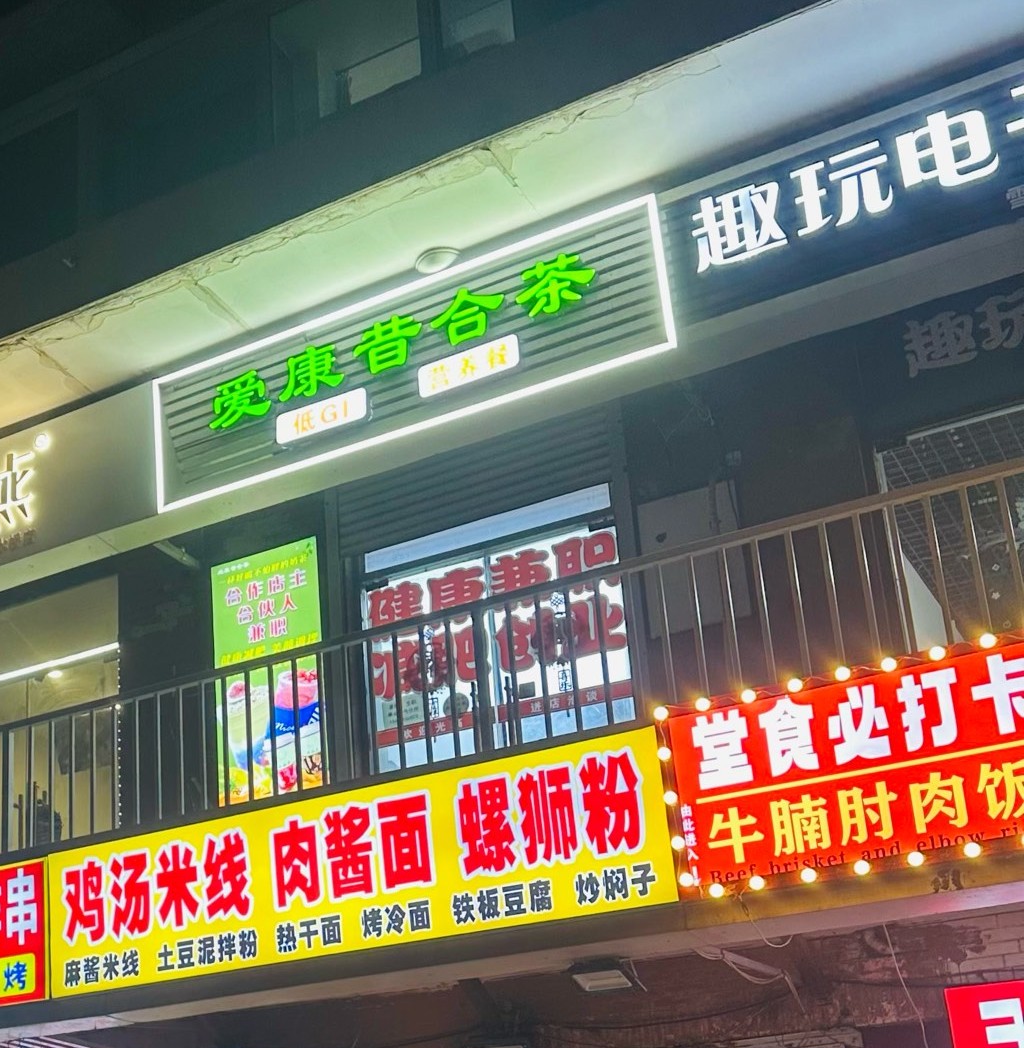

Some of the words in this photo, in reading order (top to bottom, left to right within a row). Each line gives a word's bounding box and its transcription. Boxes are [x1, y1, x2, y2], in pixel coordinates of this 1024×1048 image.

[209, 253, 596, 430] 爱康昔合茶
[293, 400, 349, 435] 低GI
[225, 568, 307, 606] 合作店主
[237, 593, 297, 624] 合伙人
[248, 617, 288, 643] 兼职
[691, 653, 1024, 790] 堂食必打卡
[708, 759, 1024, 864] 牛腩肘肉饭
[62, 826, 251, 945] 鸡汤米线
[273, 794, 433, 909] 肉酱面
[861, 841, 900, 862] and
[63, 950, 140, 987] 麻酱米线
[157, 930, 258, 973] 土豆泥拌粉
[276, 914, 342, 954] 热干面
[361, 900, 431, 938] 烤冷面
[452, 881, 552, 925] 铁板豆腐
[576, 864, 656, 907] 炒焖子
